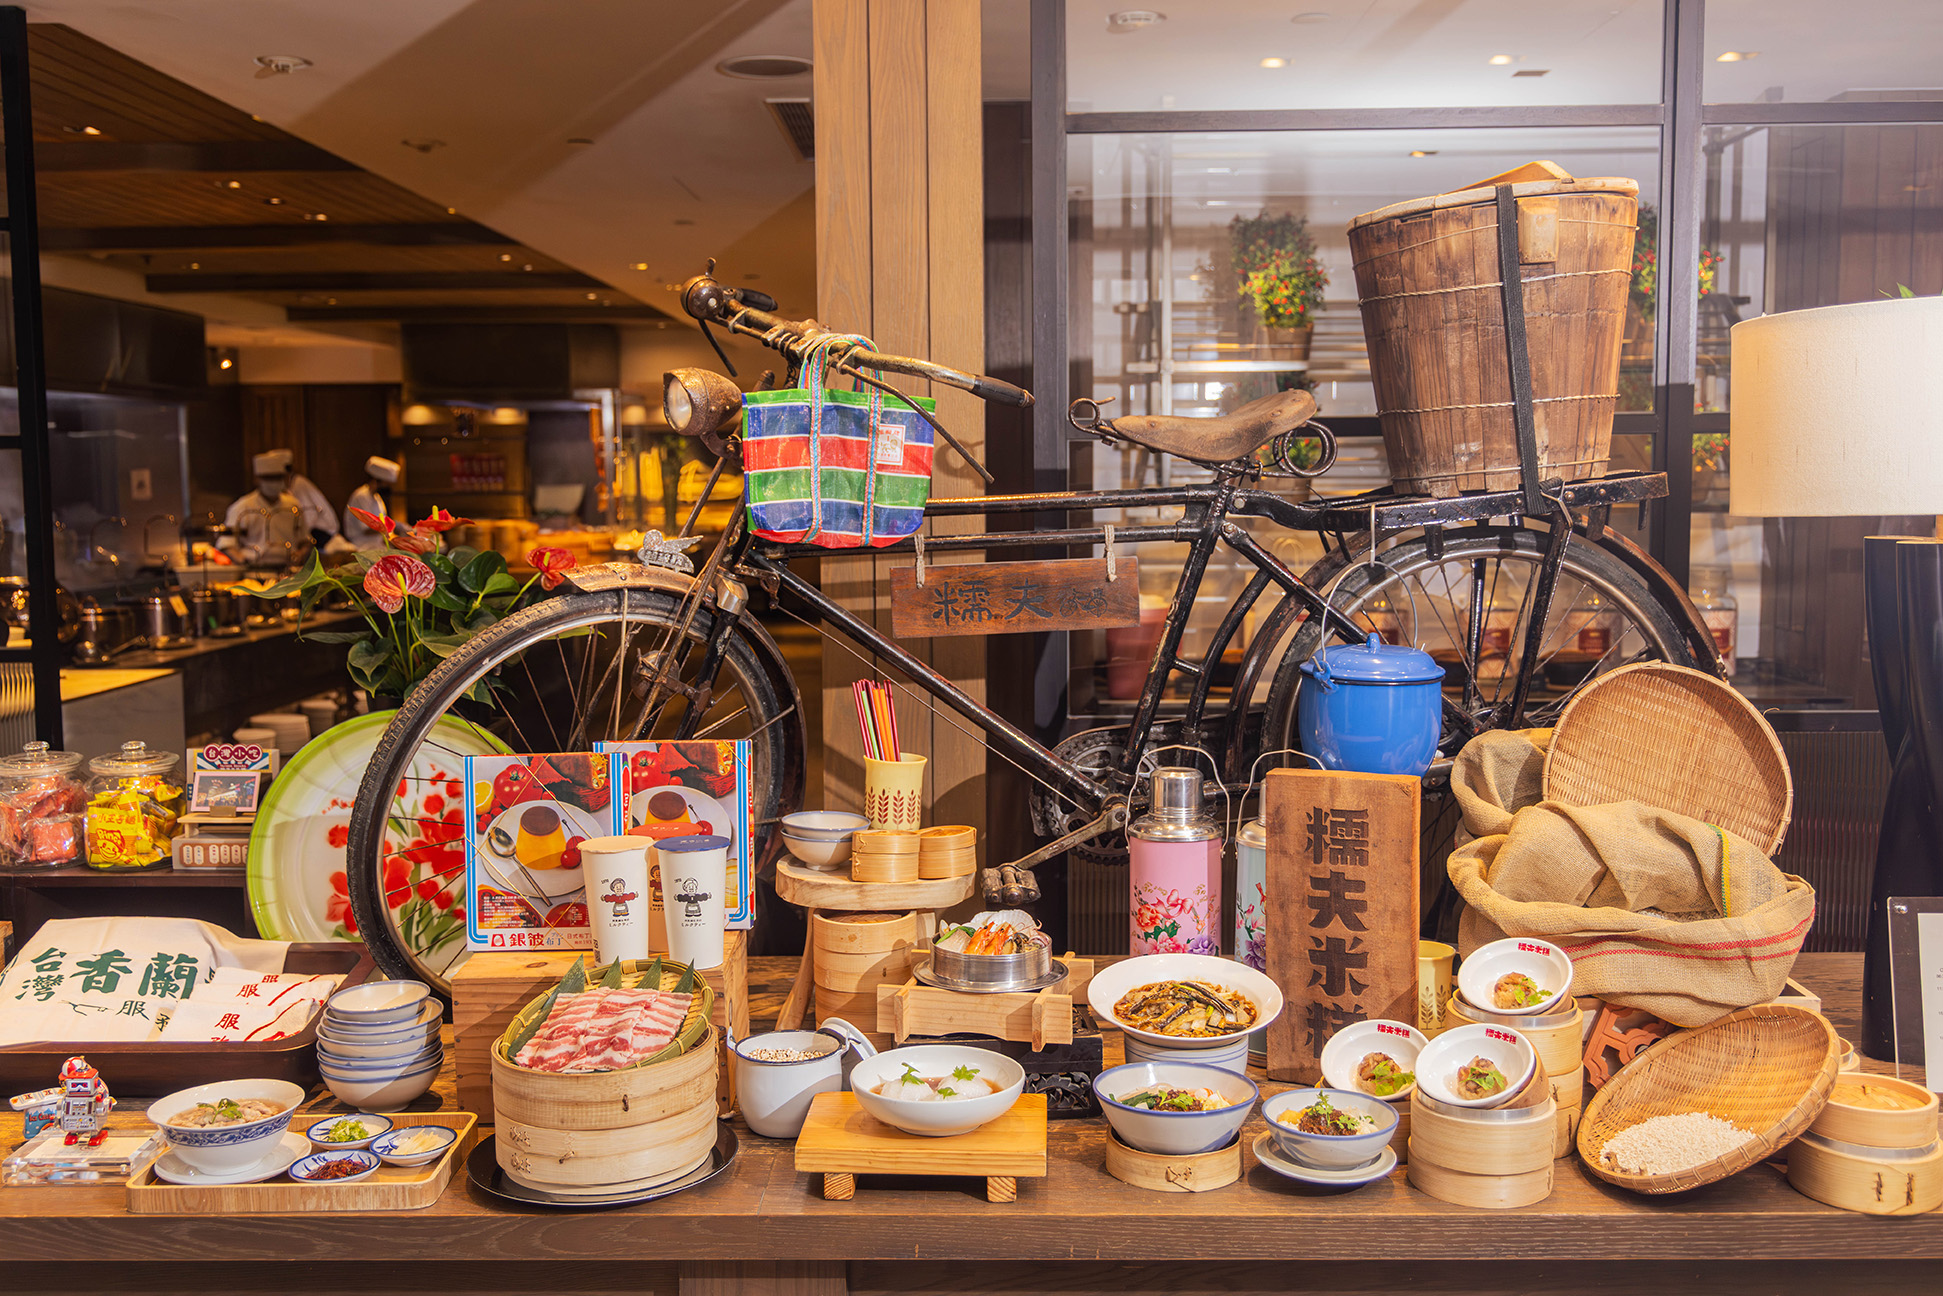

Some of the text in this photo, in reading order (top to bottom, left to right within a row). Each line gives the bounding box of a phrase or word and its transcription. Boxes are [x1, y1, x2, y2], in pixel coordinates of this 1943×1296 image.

[932, 578, 1054, 626] 糯夫
[208, 748, 259, 758] 台灣小吃
